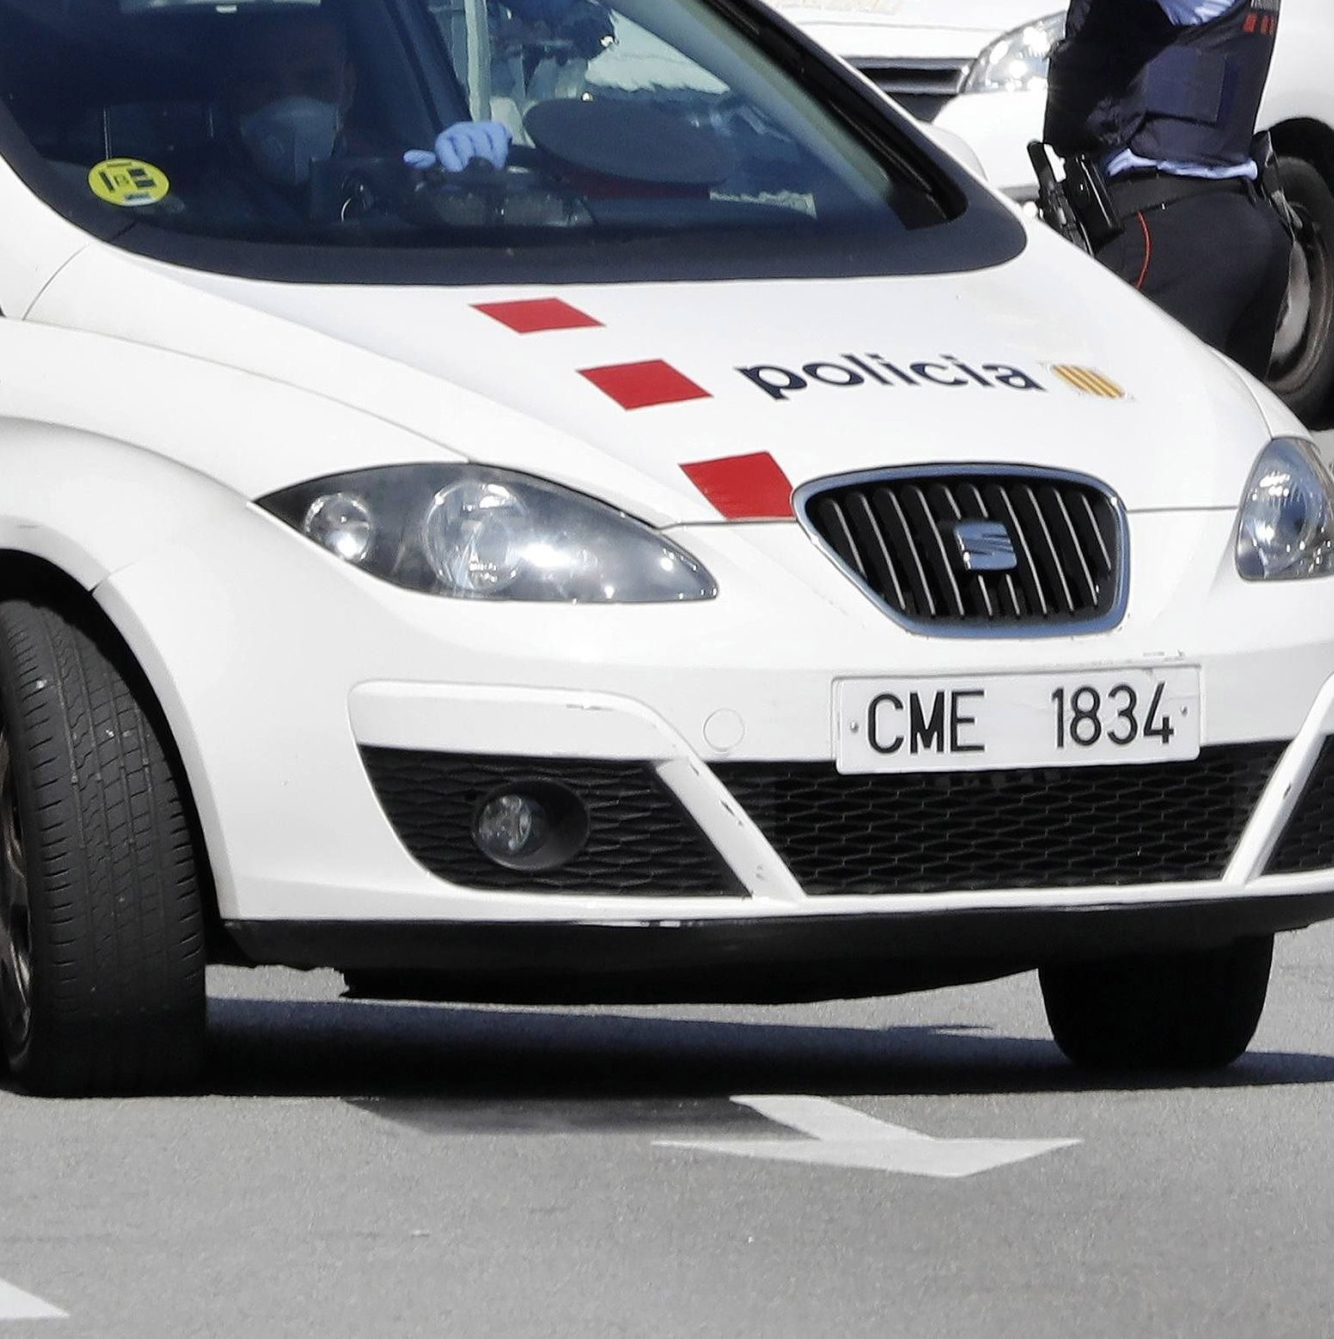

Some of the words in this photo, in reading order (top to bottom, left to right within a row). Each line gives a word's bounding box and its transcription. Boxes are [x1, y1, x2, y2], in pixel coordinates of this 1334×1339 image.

[733, 353, 1048, 401] policia
[867, 689, 985, 754] CME
[1051, 681, 1175, 749] 1834
